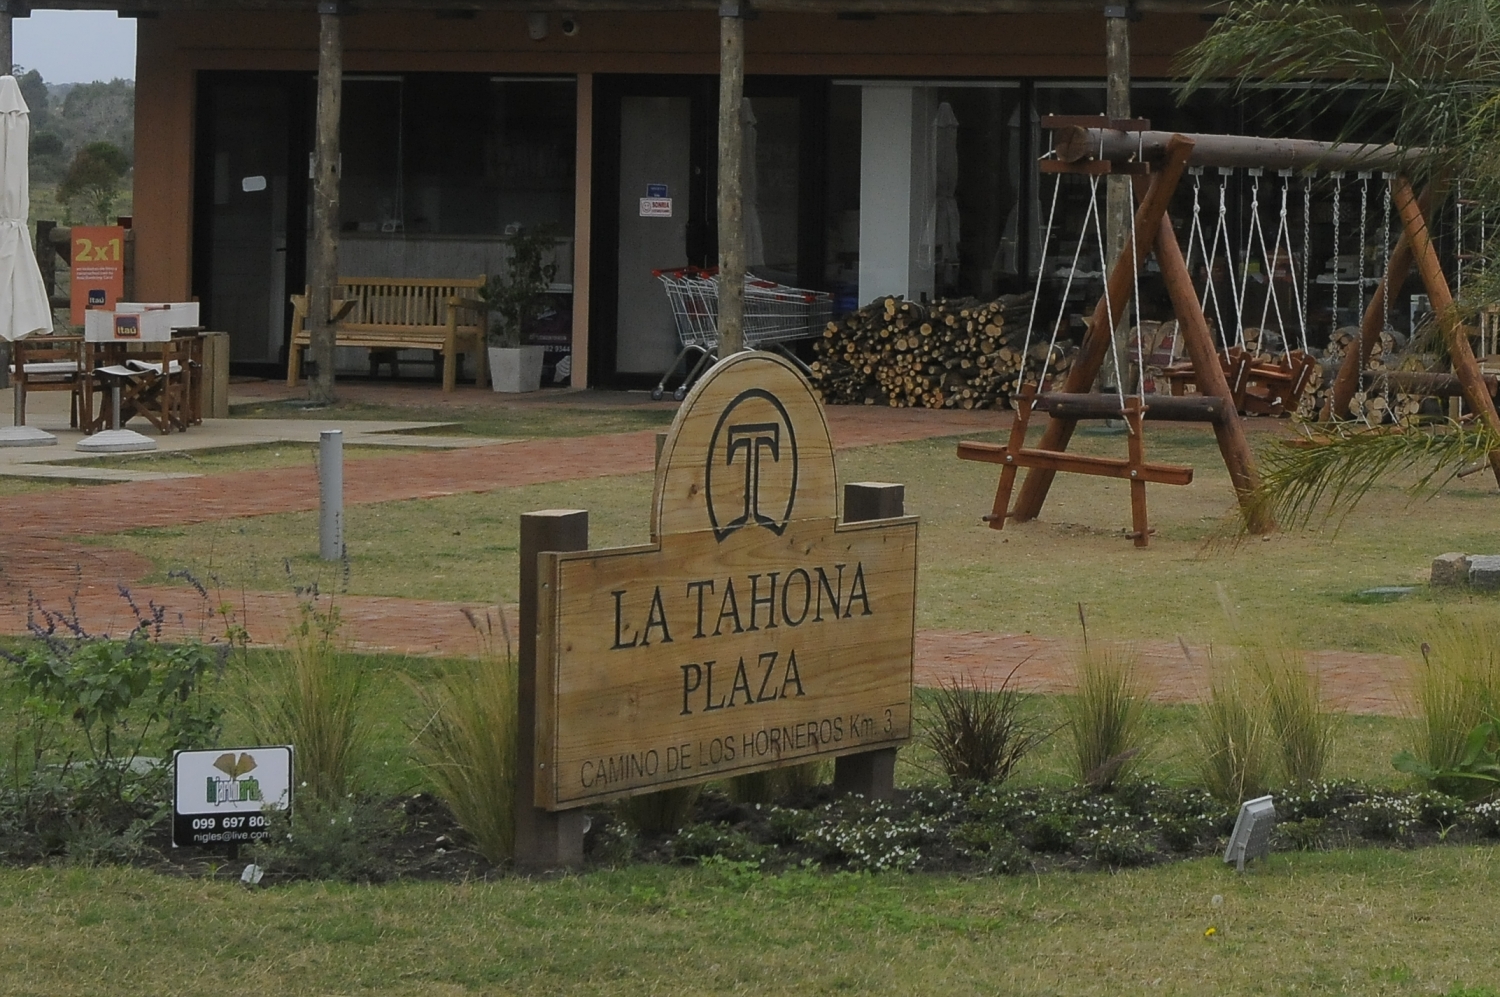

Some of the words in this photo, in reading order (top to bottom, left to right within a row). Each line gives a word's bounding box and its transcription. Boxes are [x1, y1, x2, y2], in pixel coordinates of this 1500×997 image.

[75, 238, 120, 262] 2x1
[89, 295, 105, 304] Itaú
[117, 326, 137, 334] Itaú
[609, 585, 674, 651] LA
[686, 561, 873, 639] TAHONA
[679, 649, 806, 715] PLAZA
[580, 749, 659, 789] CAMINO
[667, 743, 692, 774] DE
[699, 735, 736, 767] LOS
[743, 717, 844, 758] HORNEROS
[192, 817, 216, 830] 099
[222, 816, 246, 829] 697
